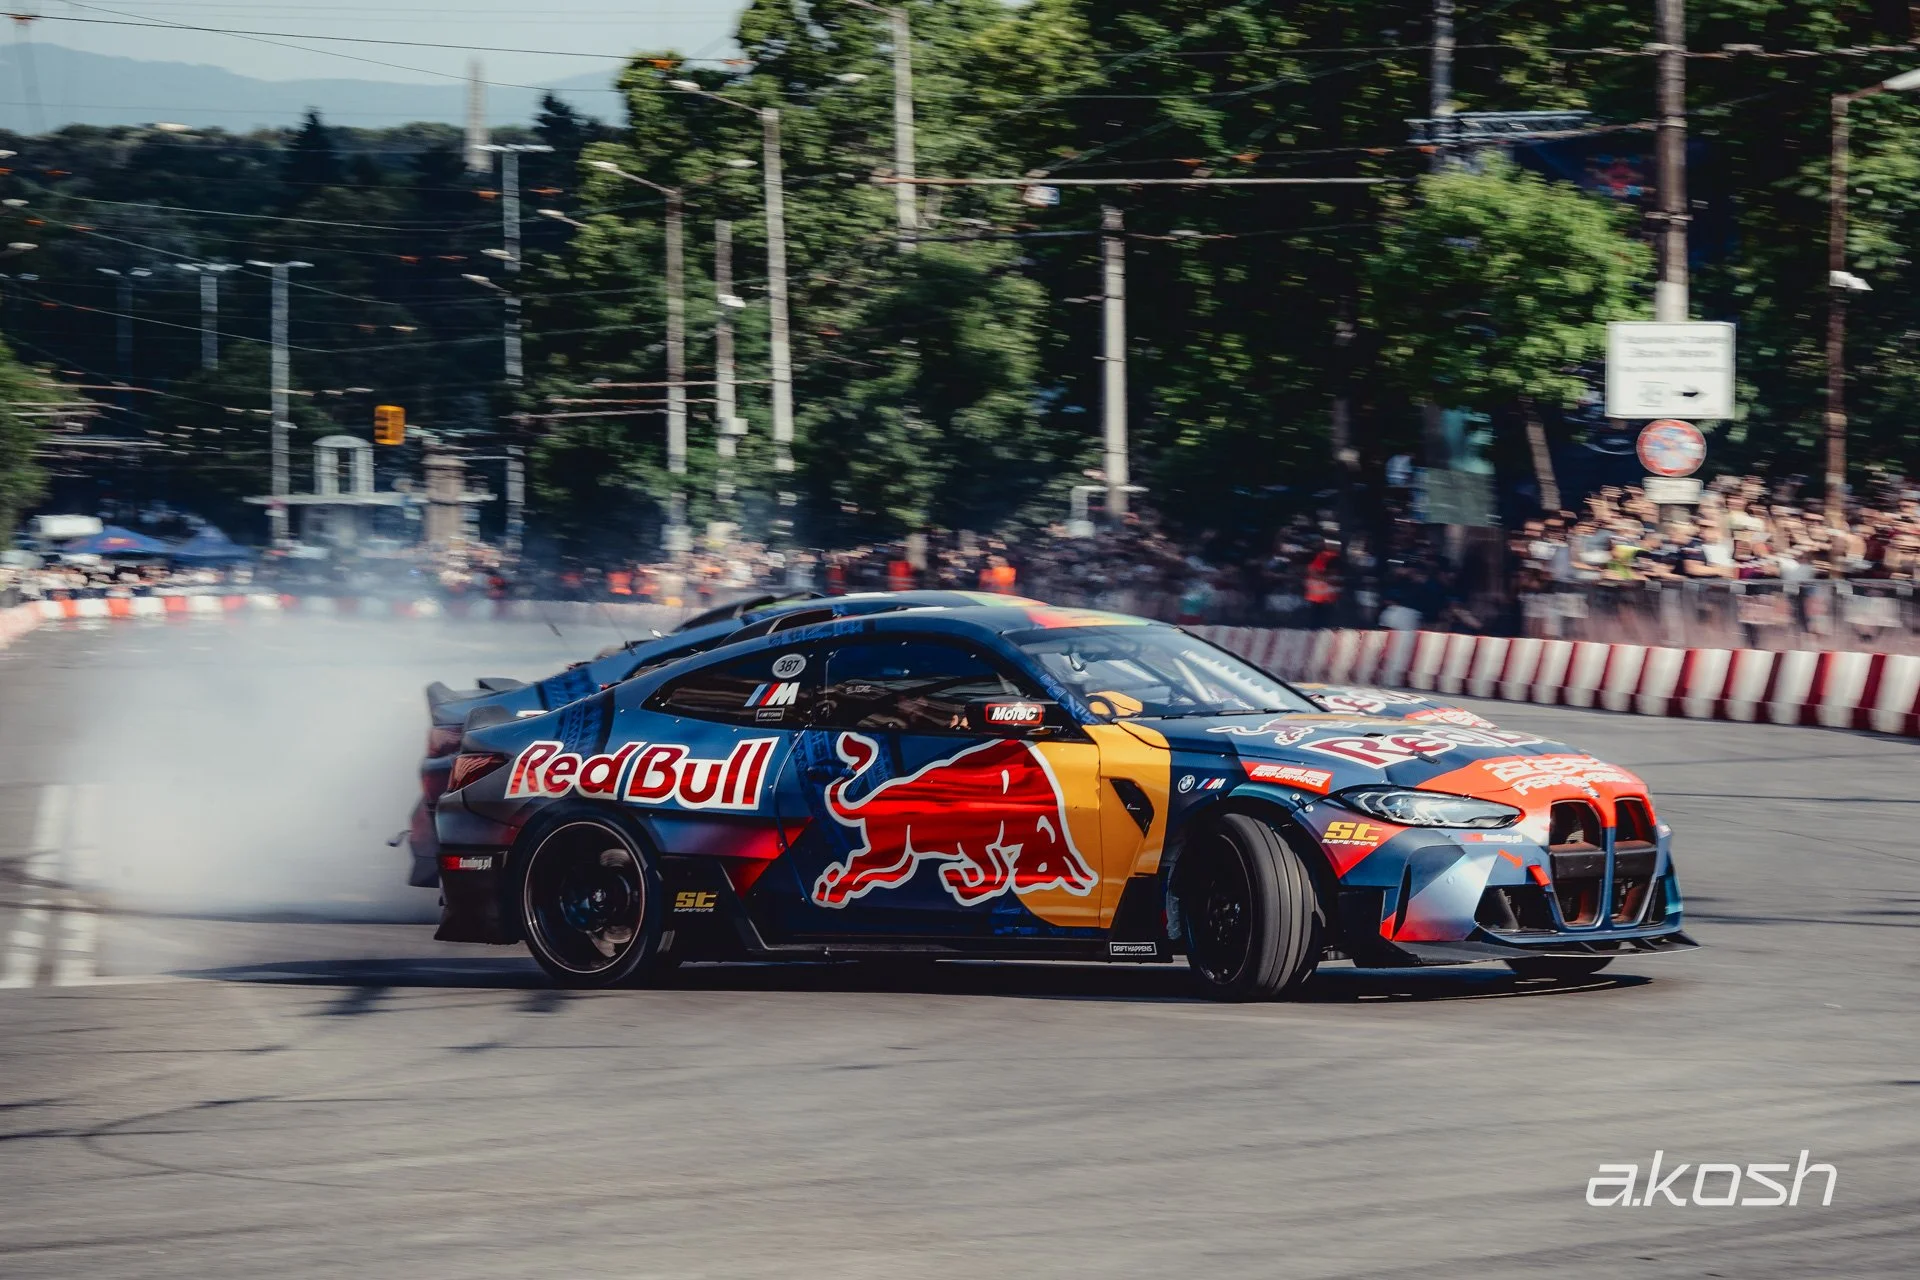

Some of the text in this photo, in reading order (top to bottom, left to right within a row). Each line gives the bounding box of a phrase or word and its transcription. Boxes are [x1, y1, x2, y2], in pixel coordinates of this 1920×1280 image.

[779, 661, 800, 672] 387
[504, 737, 780, 810] Red Bull
